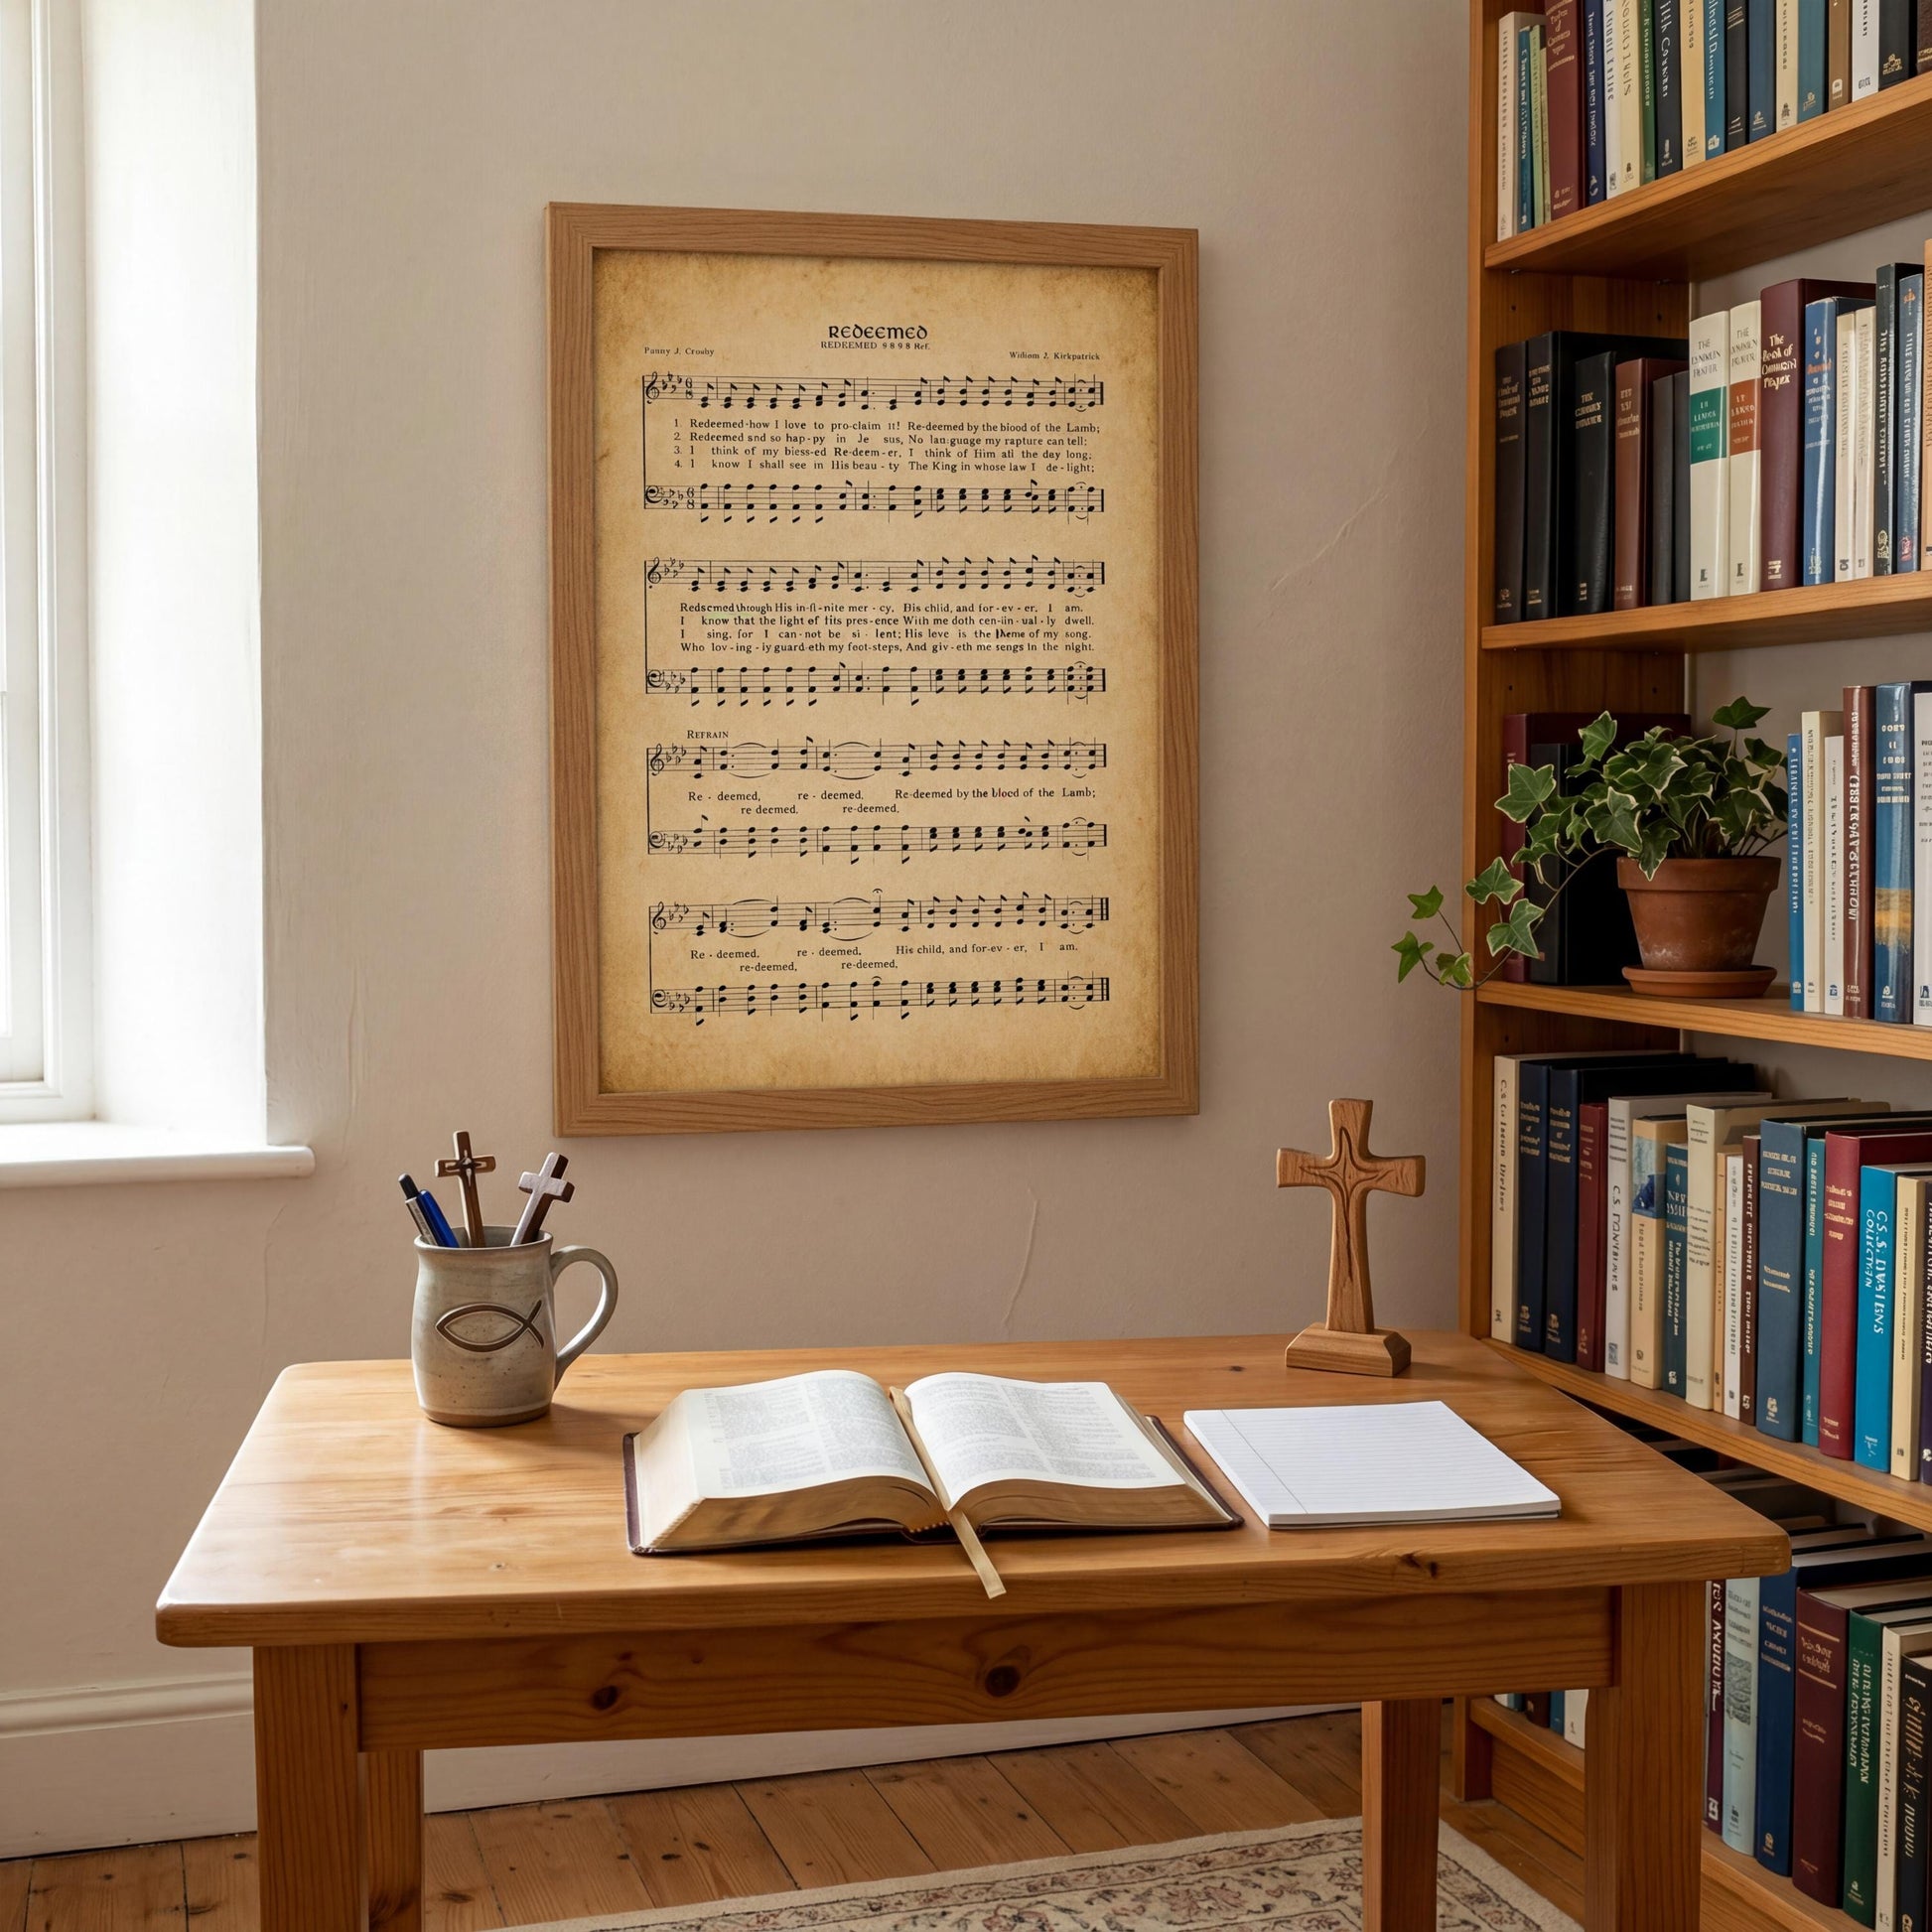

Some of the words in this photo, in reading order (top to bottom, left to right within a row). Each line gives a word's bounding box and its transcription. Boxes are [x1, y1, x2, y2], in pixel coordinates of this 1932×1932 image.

[827, 324, 928, 340] REDEEMED
[1769, 333, 1785, 346] The
[1783, 343, 1793, 357] of
[783, 419, 807, 429] love
[813, 421, 825, 430] to
[907, 421, 965, 431] Re-deemed
[966, 422, 980, 434] by
[981, 422, 999, 431] the
[1030, 423, 1041, 432] of
[1044, 423, 1061, 432] the
[1065, 423, 1100, 434] Lamb;
[836, 434, 847, 443] in
[907, 434, 924, 444] No
[984, 438, 1002, 447] my
[1004, 437, 1043, 448] rapture
[711, 445, 740, 455] think
[761, 449, 779, 458] my
[924, 449, 952, 458] think
[956, 449, 969, 458] of
[1021, 450, 1038, 459] the
[759, 460, 784, 469] shall
[907, 461, 929, 471] The
[931, 462, 958, 473] King
[960, 462, 971, 471] in
[973, 463, 1007, 472] whose
[1009, 463, 1028, 472] law
[774, 603, 794, 612] His
[954, 604, 976, 613] and
[701, 616, 730, 625] know
[733, 616, 756, 625] that
[759, 616, 776, 625] the
[779, 616, 805, 627] light
[951, 616, 976, 624] doth
[1064, 616, 1095, 624] dwell.
[737, 629, 755, 638] for
[827, 629, 841, 638] be
[904, 628, 923, 638] His
[957, 629, 967, 638] is
[973, 629, 992, 638] the
[1028, 629, 1040, 638] of
[1042, 631, 1059, 640] my
[1064, 631, 1092, 640] song.
[679, 642, 706, 651] Who
[828, 644, 845, 653] my
[904, 642, 928, 651] And
[1064, 642, 1095, 653] night.
[686, 730, 730, 739] REFRAIN
[956, 788, 970, 800] by
[971, 788, 989, 798] the
[1023, 787, 1035, 797] of
[1037, 787, 1055, 797] the
[1061, 786, 1096, 798] Lamb;
[916, 945, 945, 955] child,
[948, 944, 968, 953] and
